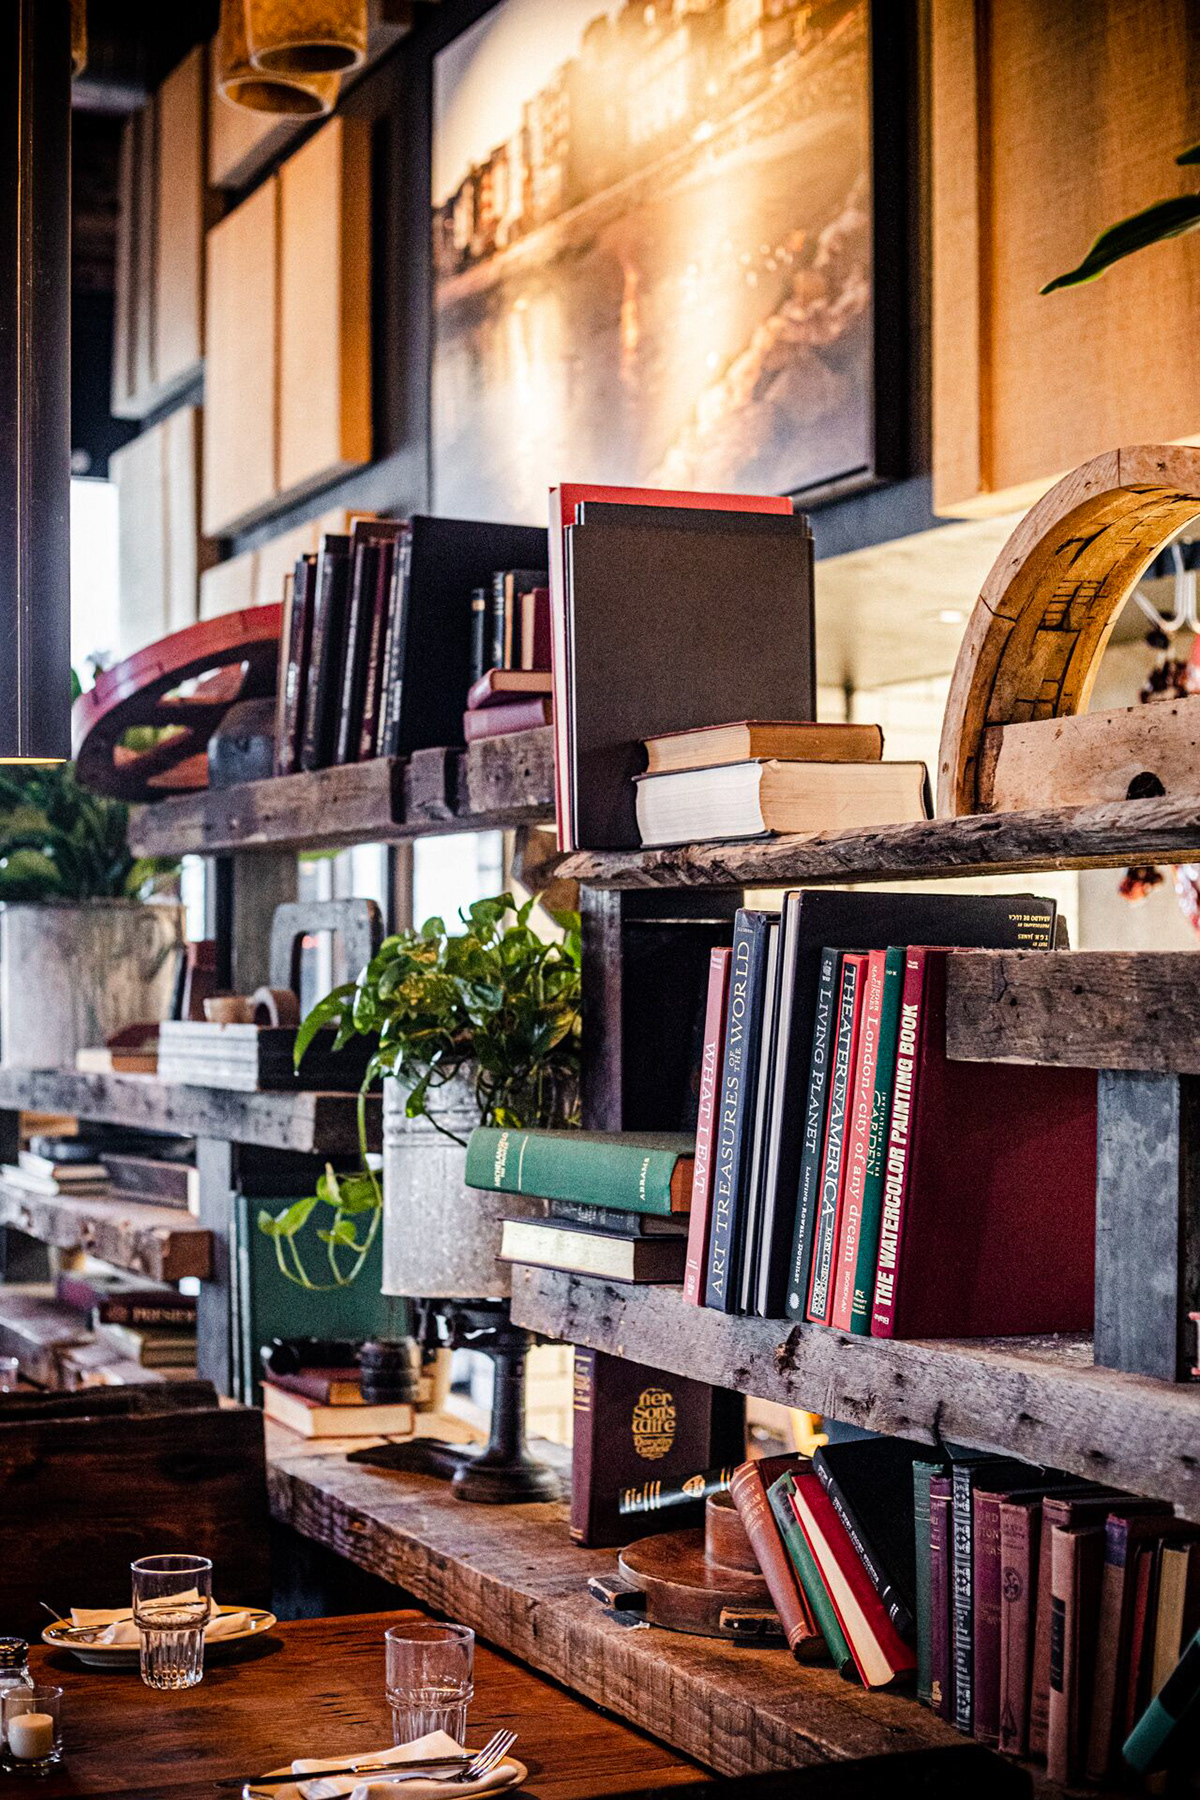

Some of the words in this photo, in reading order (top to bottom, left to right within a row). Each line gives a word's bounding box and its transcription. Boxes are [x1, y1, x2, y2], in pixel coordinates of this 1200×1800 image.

[730, 941, 750, 1045] WORLD
[813, 990, 832, 1064] LIVING
[835, 966, 857, 1081] THEATER
[899, 1003, 919, 1052] BOOK
[700, 1042, 716, 1120] WHAT
[728, 1050, 736, 1067] OF
[734, 1046, 742, 1073] THE
[861, 1017, 878, 1090] London
[805, 1070, 825, 1154] PLANET
[834, 1081, 845, 1102] IN
[889, 1052, 914, 1146] PAINTING
[699, 1126, 710, 1136] I
[855, 1104, 867, 1138] city
[695, 1143, 710, 1194] EAT
[716, 1076, 739, 1233] TREASURES
[822, 1101, 844, 1218] AMERICA
[849, 1166, 862, 1199] any
[854, 1146, 865, 1164] of
[844, 1204, 860, 1262] dream
[878, 1146, 906, 1270] WATERCOLOR
[711, 1240, 727, 1298] ART
[874, 1270, 895, 1307] THE
